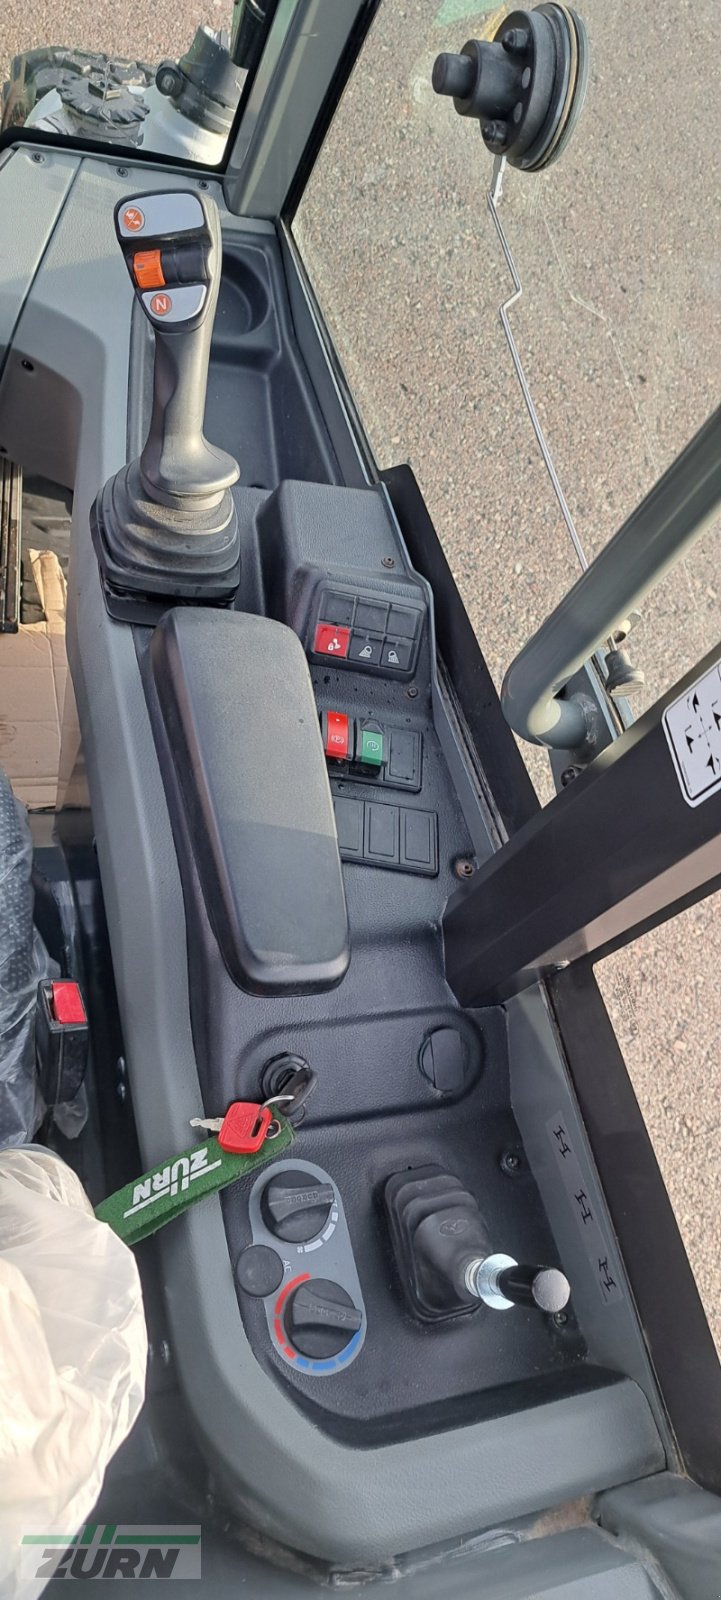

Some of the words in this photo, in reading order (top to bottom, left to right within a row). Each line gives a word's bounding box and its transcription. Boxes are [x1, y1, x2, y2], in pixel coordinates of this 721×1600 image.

[155, 298, 167, 311] N
[132, 1147, 208, 1206] ZÜRN
[282, 1260, 292, 1273] AC
